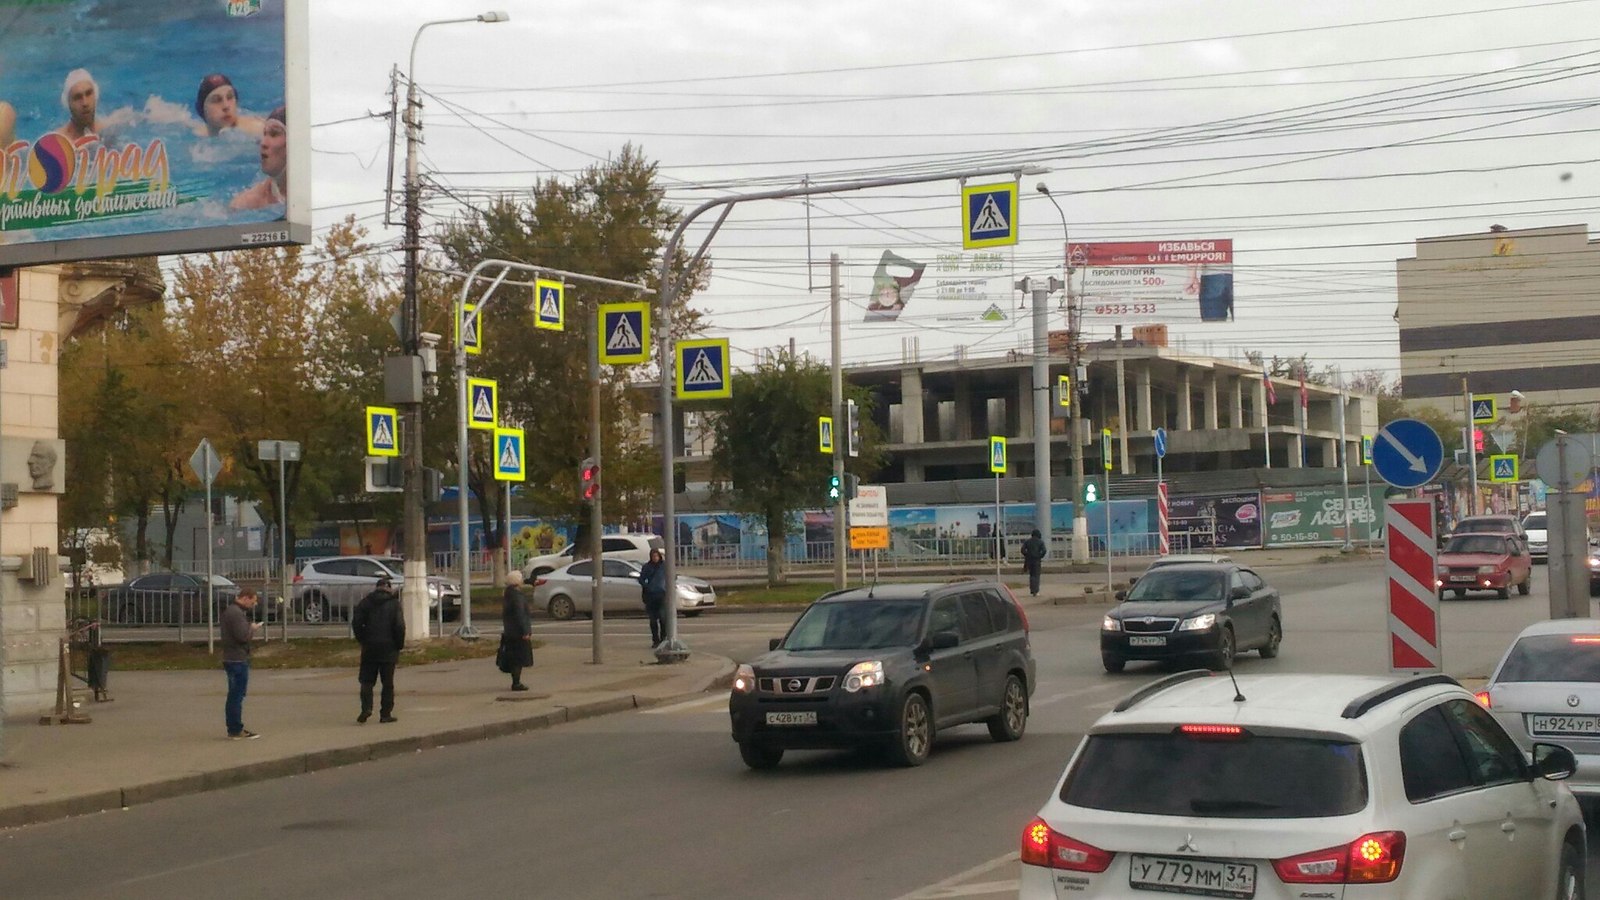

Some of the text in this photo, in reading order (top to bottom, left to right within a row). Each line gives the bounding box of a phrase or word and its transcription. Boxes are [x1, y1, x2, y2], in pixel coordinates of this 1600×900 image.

[251, 233, 278, 243] 22216
[1158, 242, 1216, 252] ИЗБАВЬСЯ
[1092, 267, 1156, 277] ПРОКТОЛОГИЯ
[1105, 303, 1156, 314] 533-533
[1188, 524, 1236, 534] PATRCIA
[1280, 532, 1319, 541] 50-15-50
[1539, 717, 1594, 731] Н924УР
[1141, 861, 1246, 887] У779ММ 34
